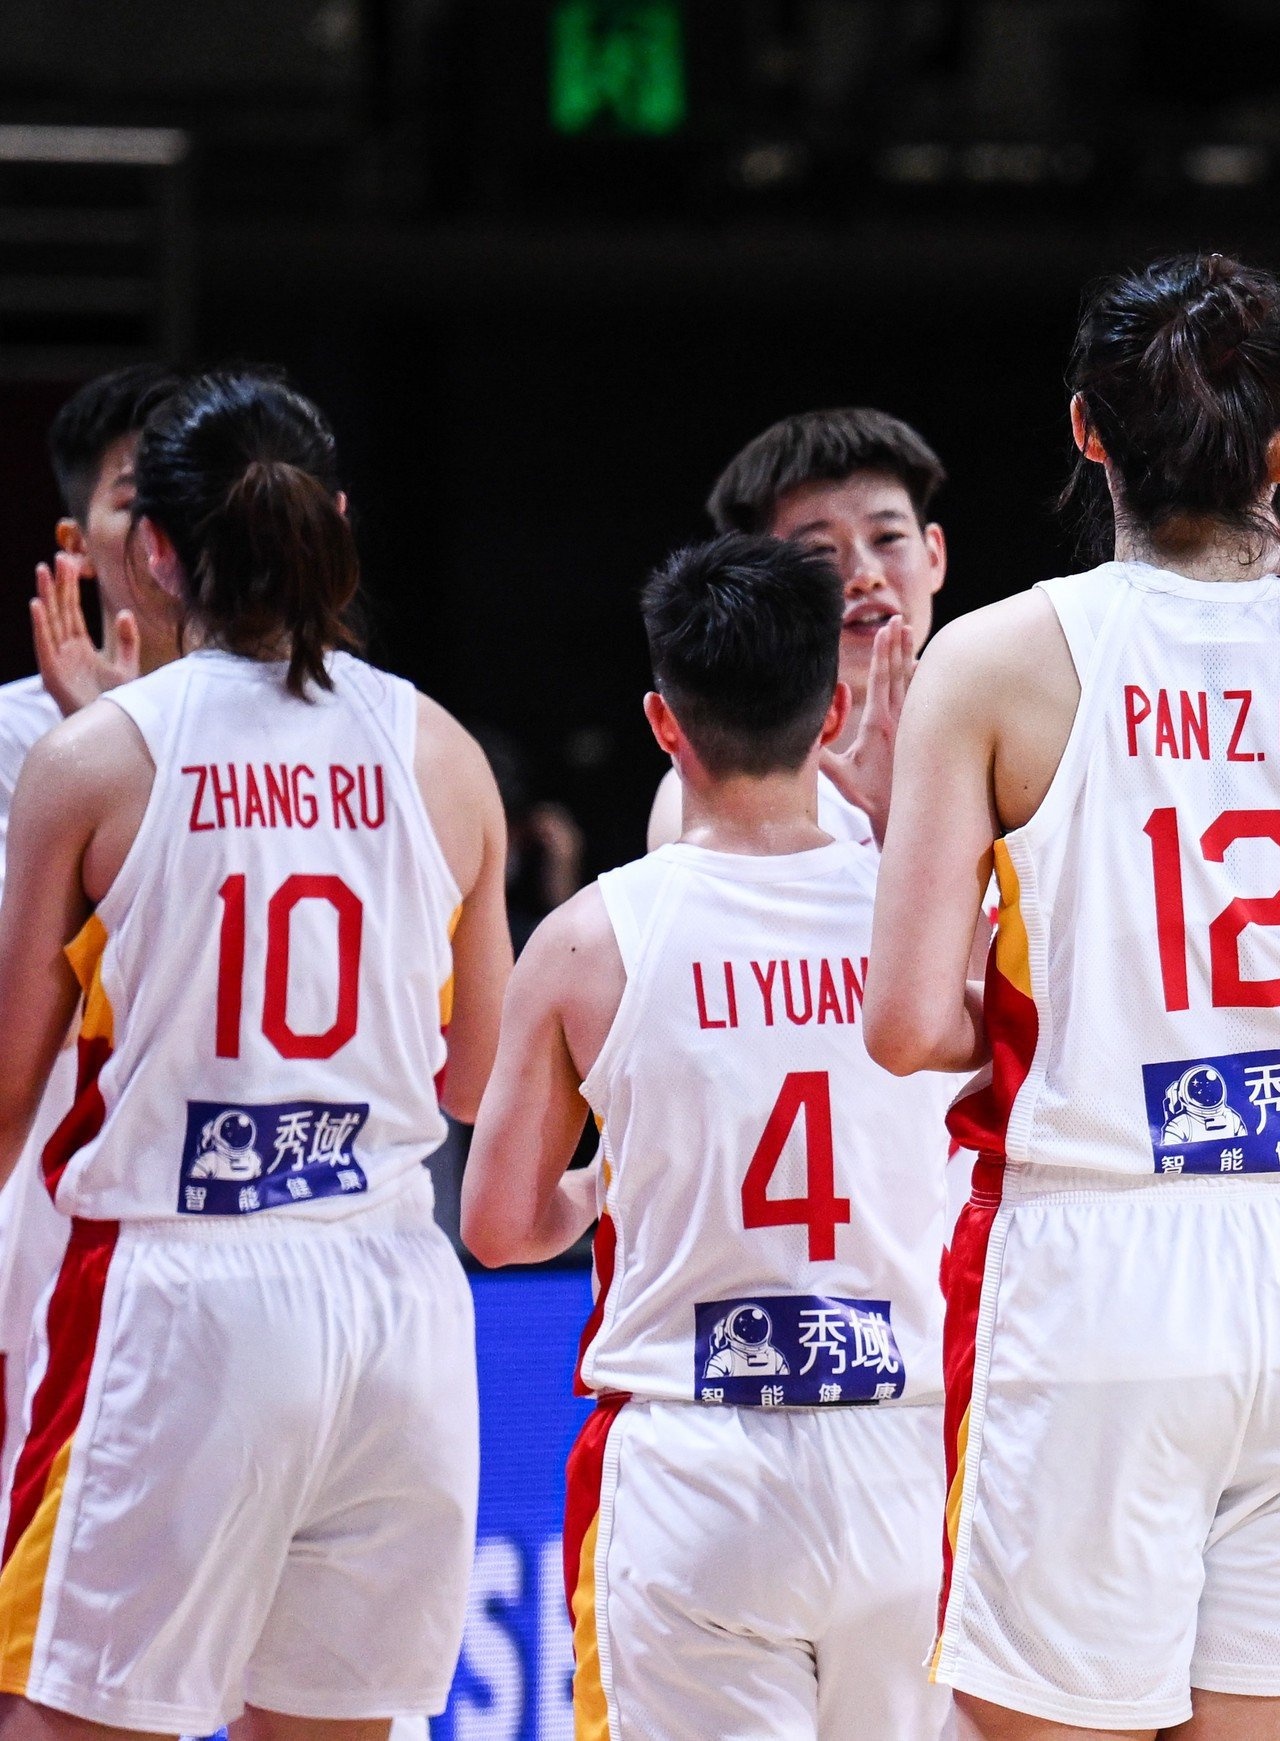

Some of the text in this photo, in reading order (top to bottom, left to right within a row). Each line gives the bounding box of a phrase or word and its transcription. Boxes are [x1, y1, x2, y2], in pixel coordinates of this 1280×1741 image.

[1124, 684, 1211, 761] PAN
[183, 763, 385, 832] ZHANG RU
[215, 873, 364, 1060] 10
[692, 956, 869, 1029] LI YUAN
[266, 1110, 360, 1175] 秀域
[740, 1070, 852, 1262] 4
[797, 1308, 899, 1376] 秀域
